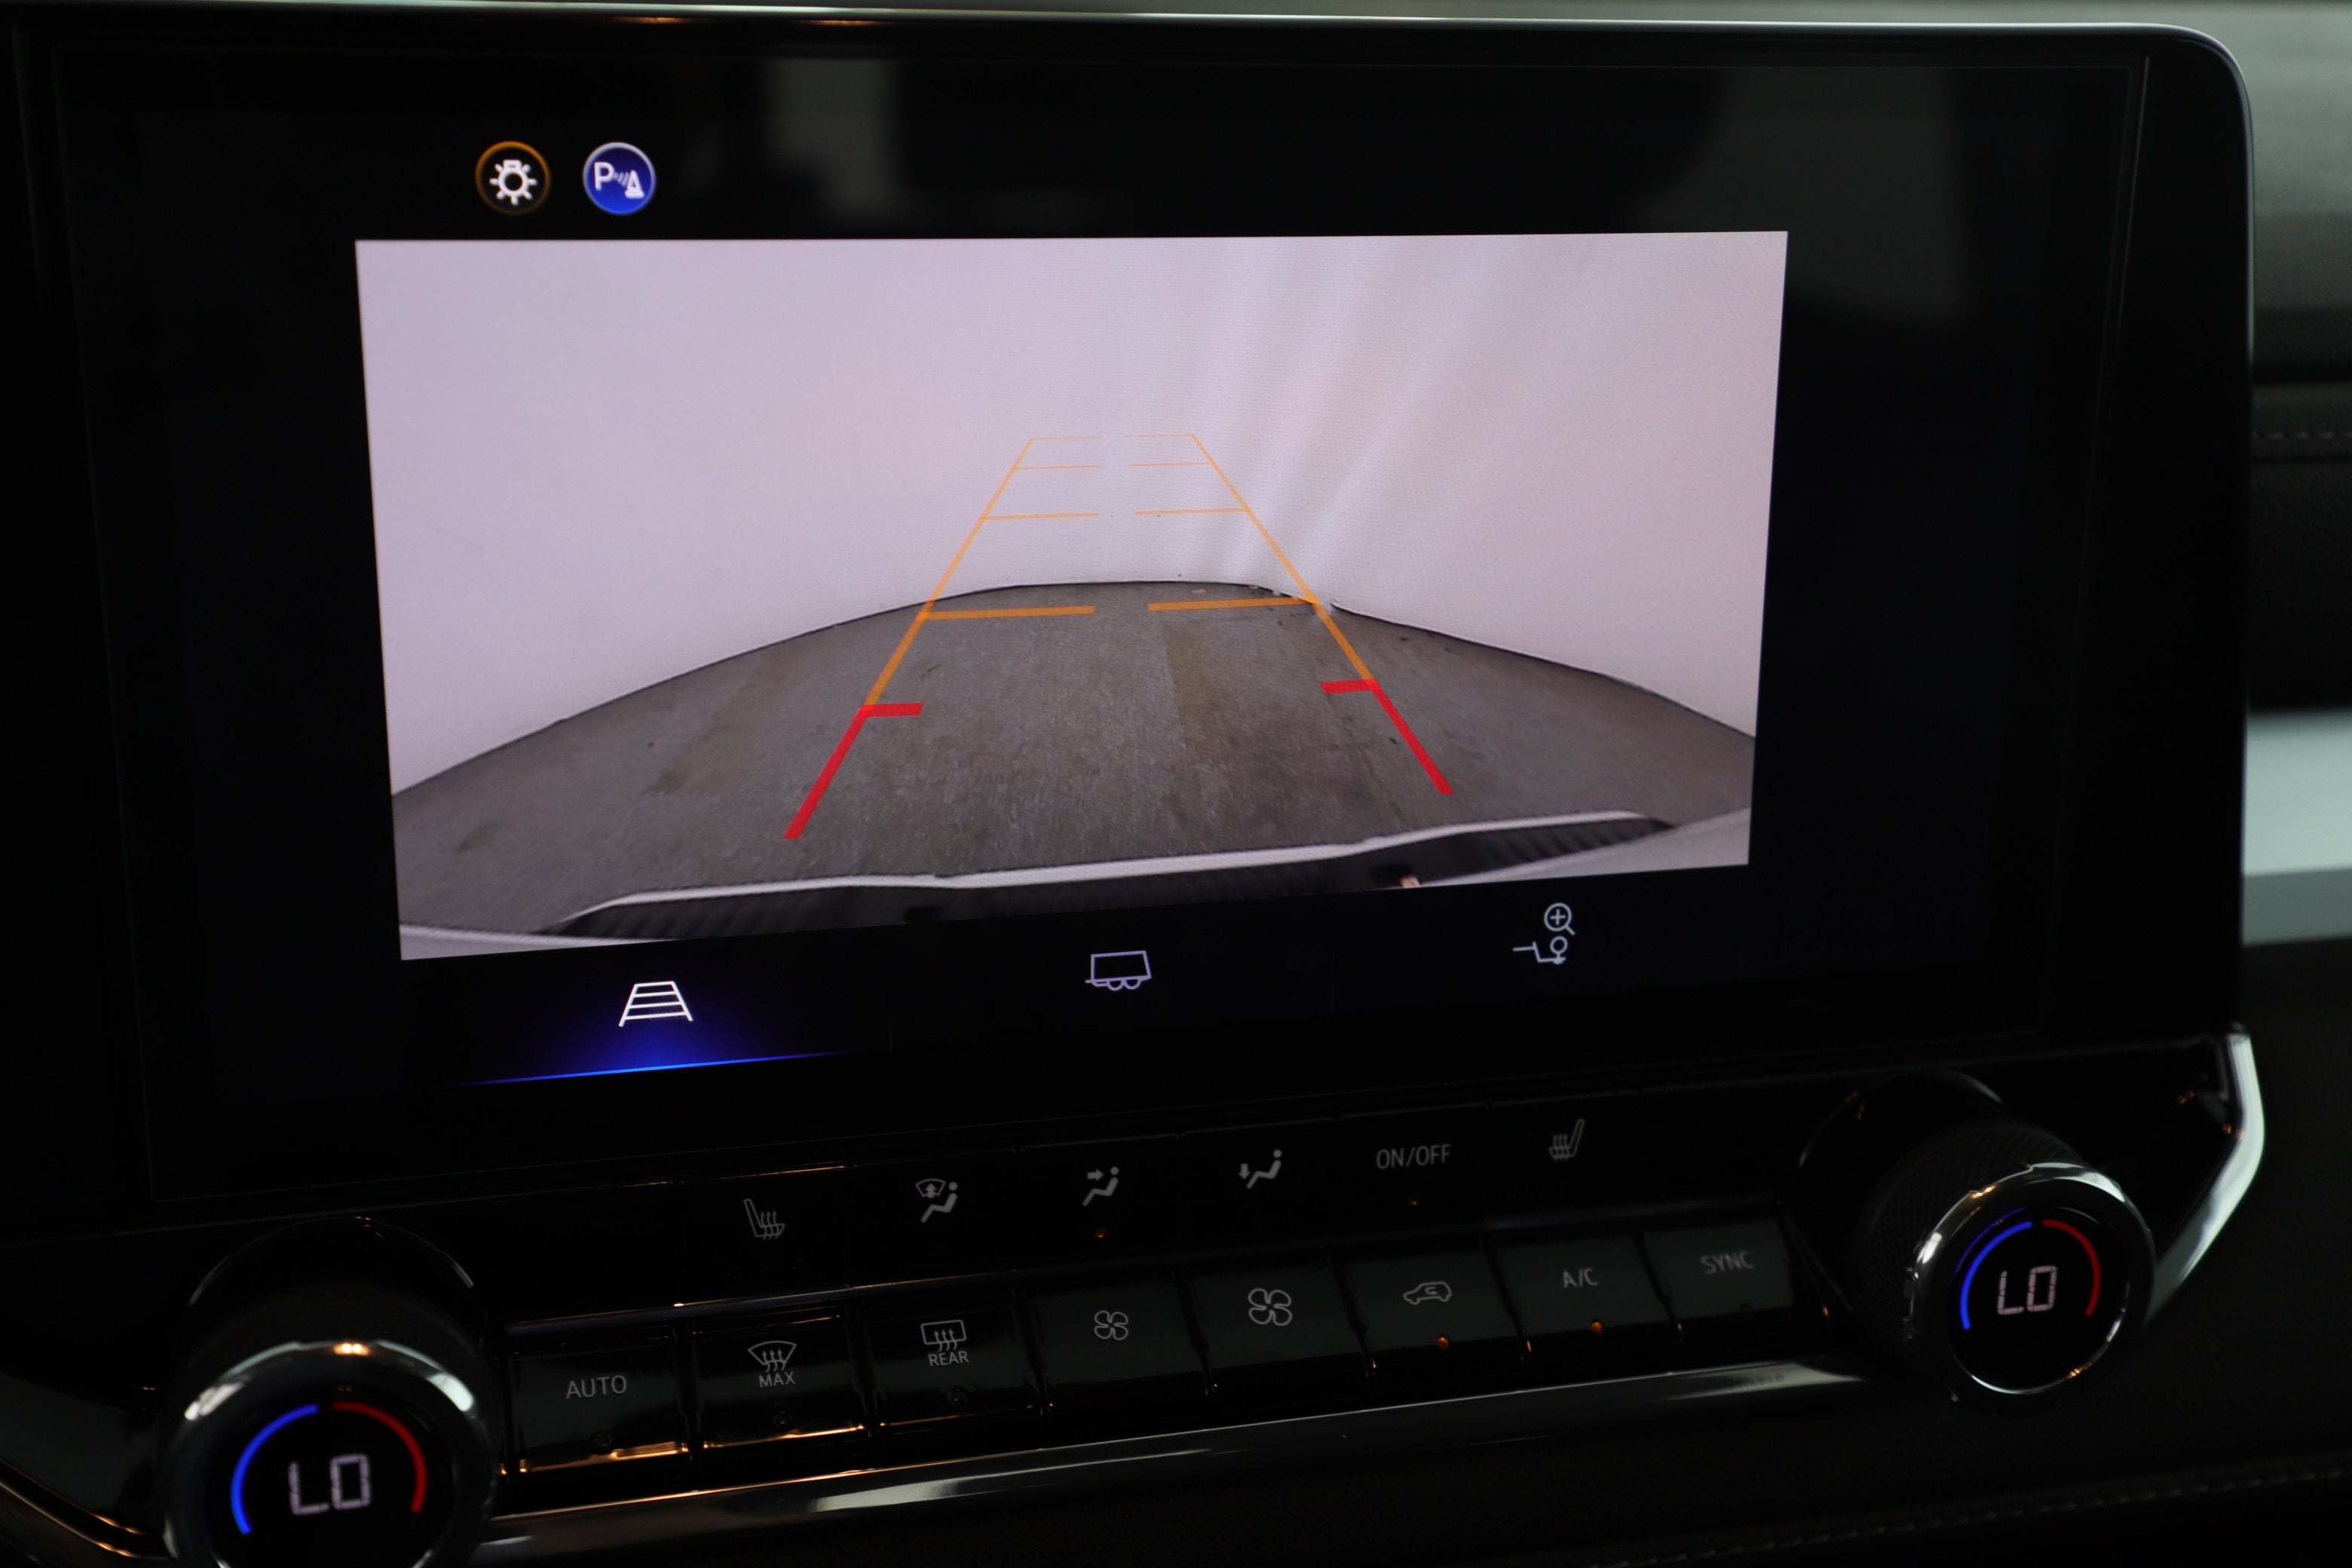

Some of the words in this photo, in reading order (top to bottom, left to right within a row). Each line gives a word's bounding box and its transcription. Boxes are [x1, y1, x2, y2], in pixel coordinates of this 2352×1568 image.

[1376, 1143, 1451, 1169] ON/OFF
[1701, 1250, 1755, 1274] SYNC
[1563, 1267, 1599, 1288] A/C
[1997, 1265, 2057, 1315] LO
[928, 1350, 969, 1367] REAR
[565, 1374, 627, 1400] AUTO
[758, 1370, 795, 1389] MAX
[288, 1453, 372, 1517] LO
